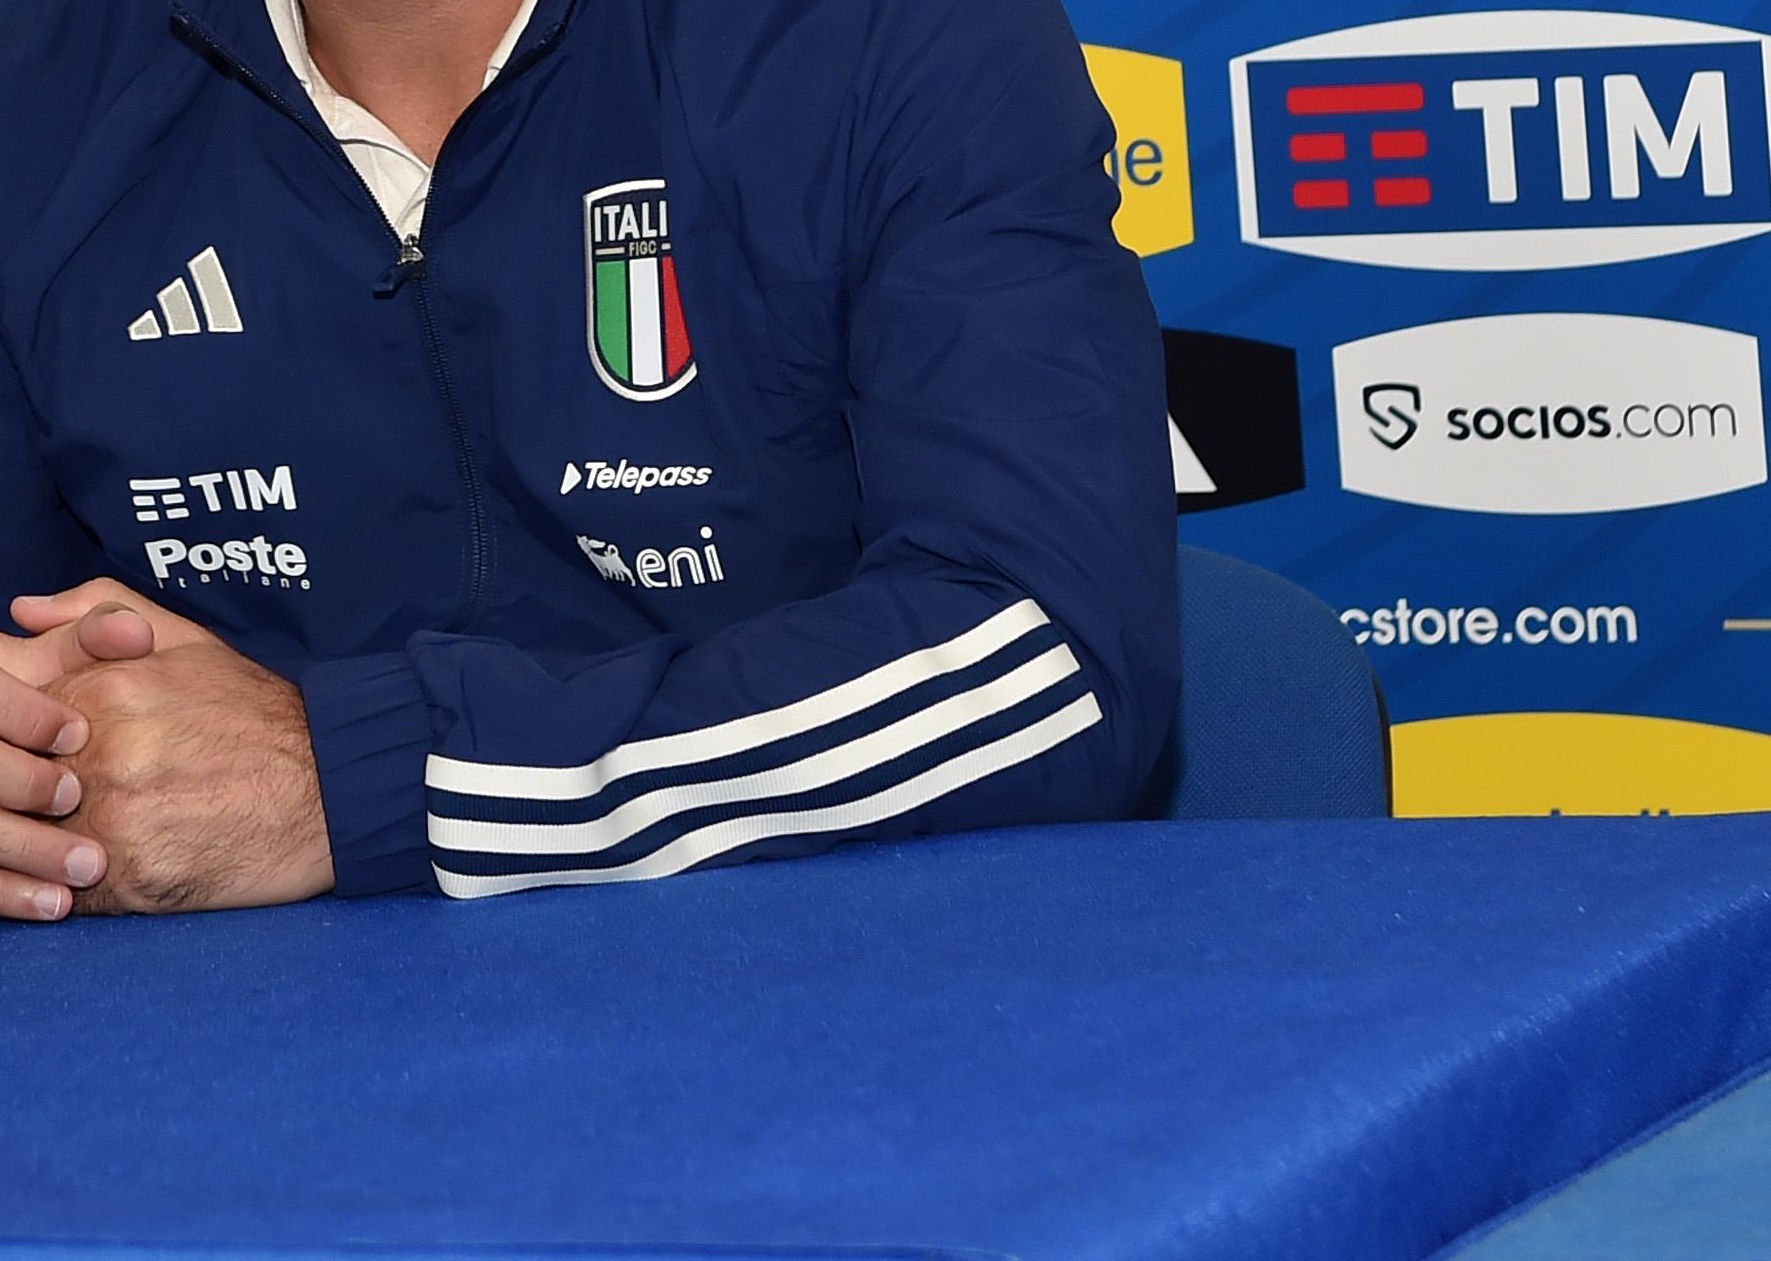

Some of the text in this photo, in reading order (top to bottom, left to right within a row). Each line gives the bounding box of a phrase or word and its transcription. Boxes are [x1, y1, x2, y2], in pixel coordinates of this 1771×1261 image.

[1453, 72, 1732, 202] TIM
[594, 200, 667, 242] ITALI
[628, 241, 657, 256] FIGC
[189, 466, 296, 511] TIM
[584, 459, 713, 494] Telepass
[144, 535, 307, 577] Poste
[636, 526, 724, 587] eni
[157, 570, 310, 590] italiane
[1340, 598, 1638, 646] cstore.com
